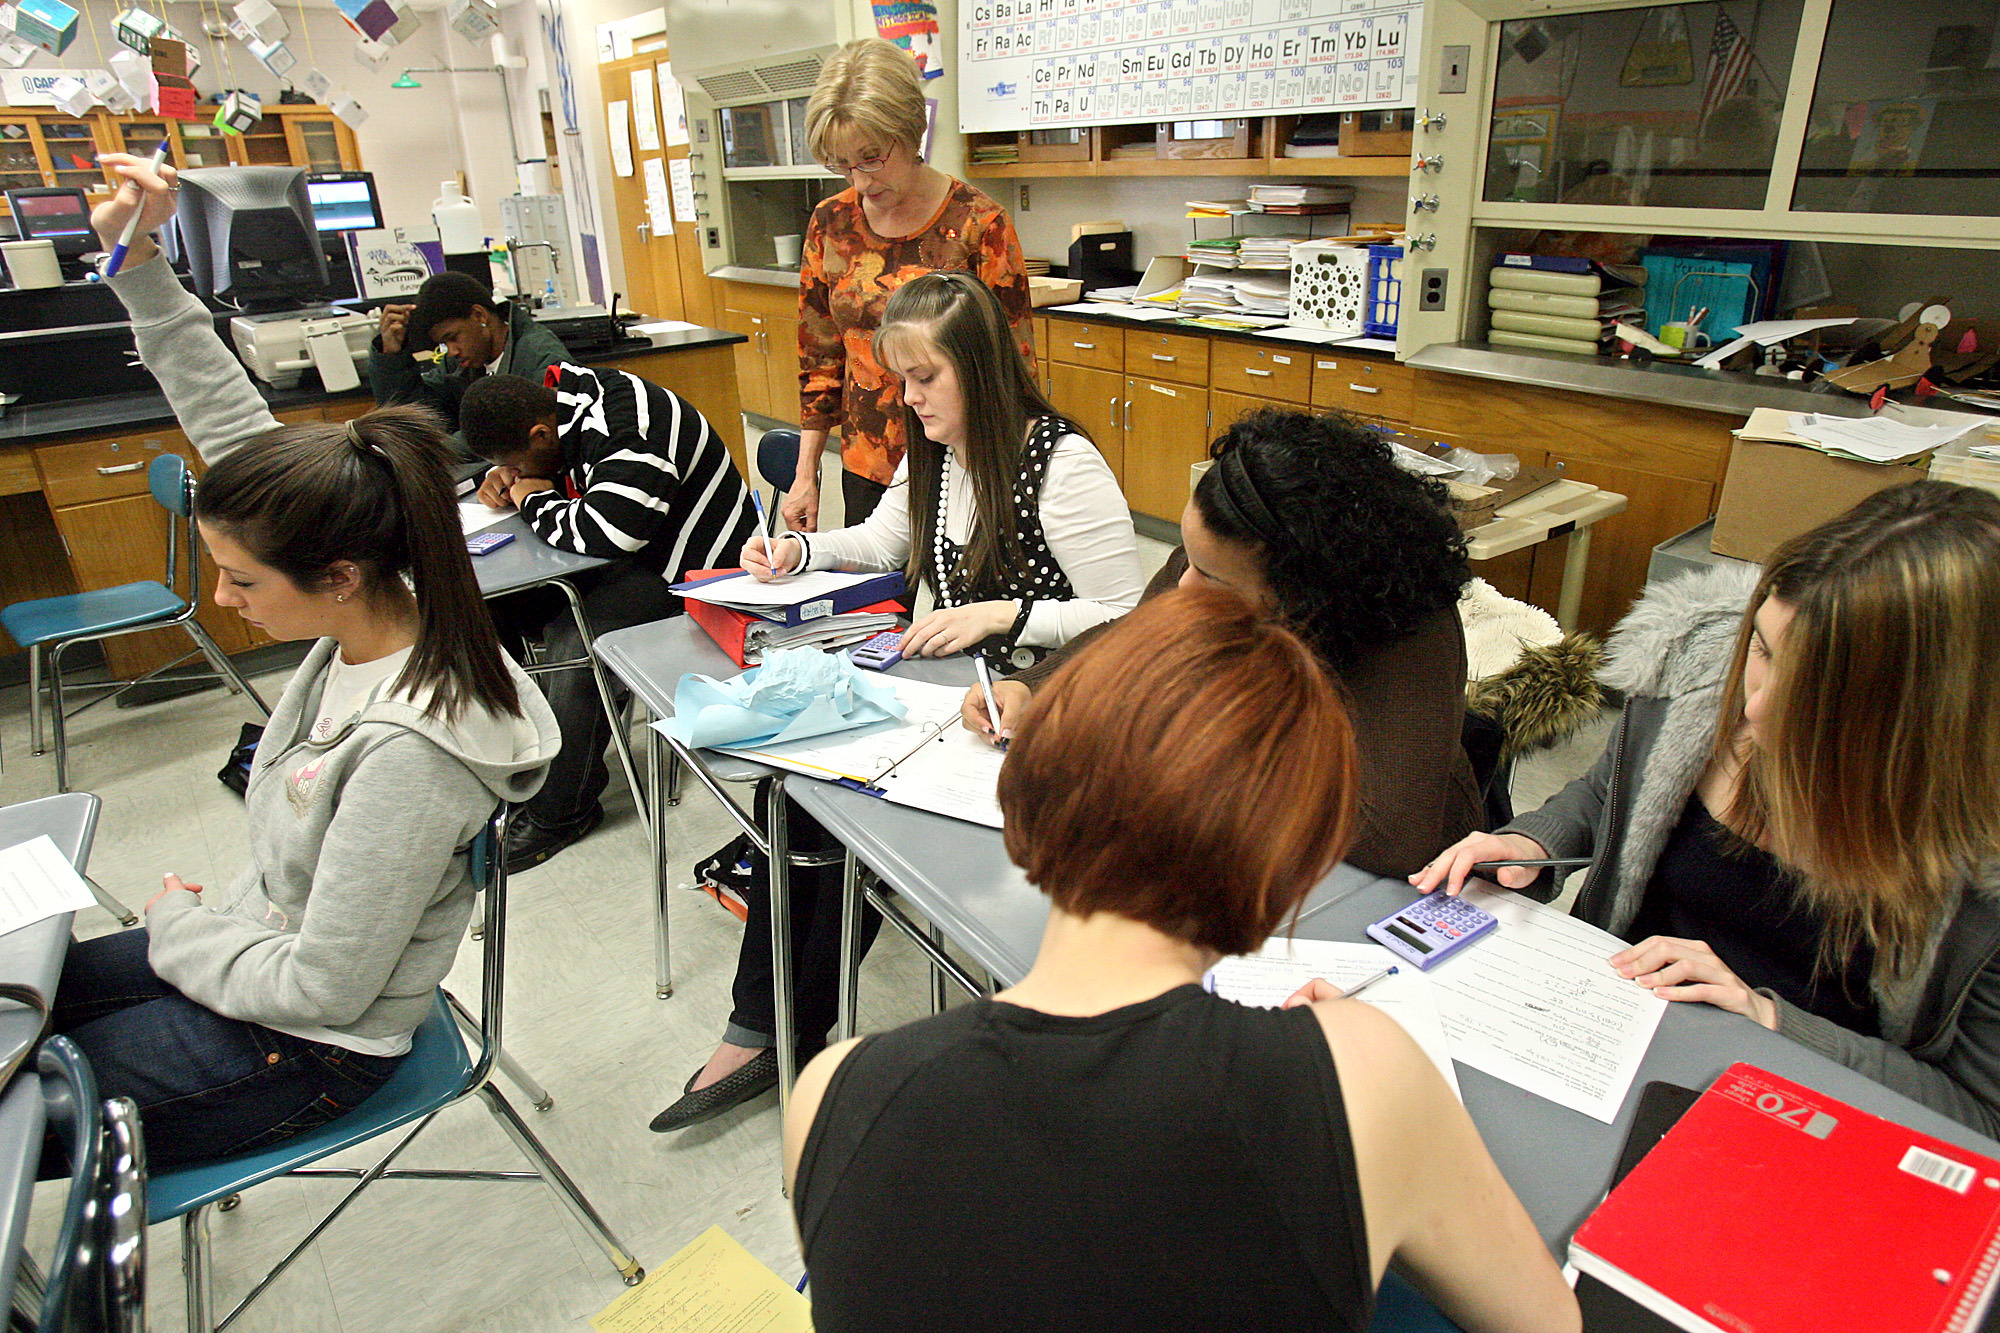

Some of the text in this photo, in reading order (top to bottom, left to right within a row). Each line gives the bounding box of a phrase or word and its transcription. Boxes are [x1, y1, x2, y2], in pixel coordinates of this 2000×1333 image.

[975, 7, 990, 21] Cs
[996, 4, 1011, 18] Ba
[1018, 2, 1032, 15] La
[976, 38, 988, 52] Fr
[995, 35, 1010, 50] Ra
[1016, 33, 1031, 47] Ac
[1080, 22, 1097, 39] Sg
[1103, 19, 1120, 36] Bh
[1125, 16, 1143, 33] Hs
[1150, 12, 1167, 30] Mt
[1186, 41, 1195, 50] 64
[1212, 37, 1220, 46] 65
[1268, 30, 1278, 40] 67
[1297, 27, 1308, 36] 68
[1328, 23, 1339, 33] 69
[1361, 18, 1373, 28] 70
[1397, 15, 1408, 24] 71
[1035, 69, 1051, 82] Ce
[1058, 66, 1071, 80] Pr
[1078, 63, 1095, 78] Nd
[1122, 58, 1142, 74] Sm
[1148, 56, 1164, 71] Eu
[1171, 51, 1191, 69] Gd
[1199, 49, 1216, 65] Tb
[1224, 46, 1244, 63] Dy
[1252, 43, 1273, 60] Ho
[1283, 40, 1301, 57] Er
[1311, 36, 1335, 54] Tm
[1345, 31, 1366, 50] Yb
[1377, 28, 1399, 47] Lu
[1158, 80, 1167, 89] 95
[1183, 77, 1192, 86] 96
[1209, 75, 1218, 84] 97
[1236, 72, 1246, 82] 98
[1264, 70, 1275, 79] 99
[1290, 67, 1305, 77] 100
[1323, 64, 1336, 74] 101
[1353, 61, 1369, 72] 102
[1387, 58, 1403, 69] 103
[1035, 101, 1049, 115] Th
[1055, 99, 1069, 113] Pa
[1080, 97, 1088, 111] U
[1121, 92, 1138, 109] Pu
[1143, 91, 1164, 107] Am
[1168, 88, 1190, 105] Cm
[1194, 86, 1213, 103] Bk
[1222, 83, 1241, 101] Cf
[1249, 81, 1269, 99] Es
[1276, 79, 1301, 97] Fm
[1306, 75, 1333, 95] Md
[1339, 73, 1364, 93] No
[1376, 72, 1395, 90] Lr
[373, 274, 416, 286] Spectrum
[1730, 1084, 1755, 1097] wide
[1737, 1081, 1757, 1091] rule
[1756, 1093, 1809, 1126] 70
